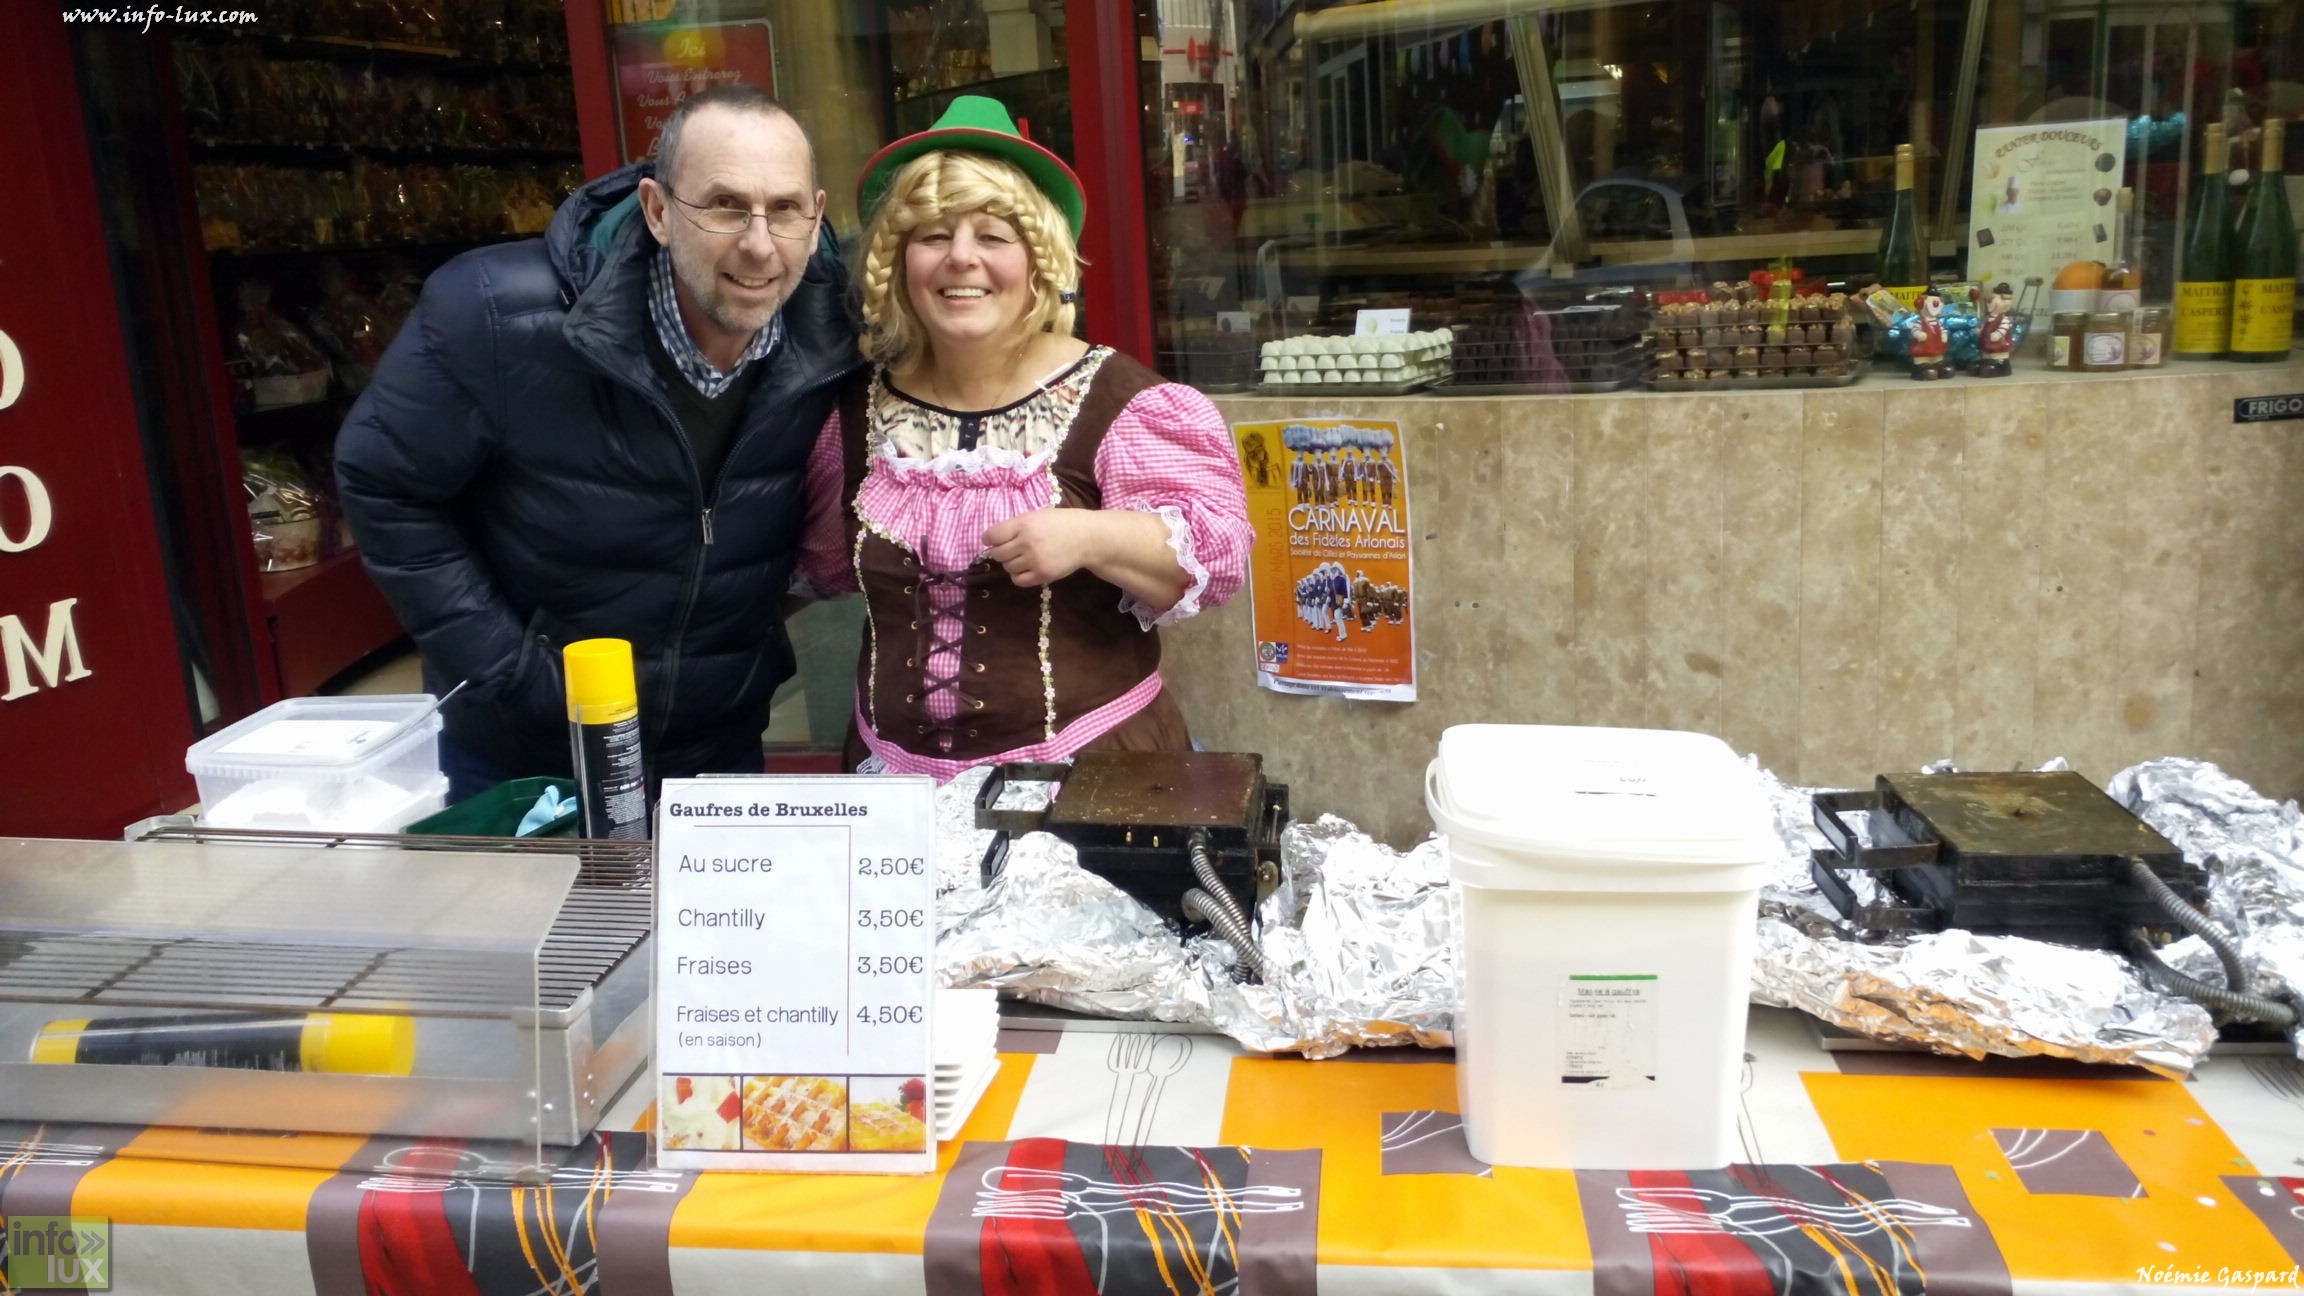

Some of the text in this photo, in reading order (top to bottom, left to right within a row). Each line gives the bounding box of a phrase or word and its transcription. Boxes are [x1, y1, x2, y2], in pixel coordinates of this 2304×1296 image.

[677, 37, 706, 58] Ici
[648, 70, 682, 84] Vous
[637, 93, 671, 107] Vous
[2248, 398, 2303, 415] FRIGO
[1288, 506, 1406, 534] CARNAVAL
[1289, 533, 1310, 546] des
[1354, 534, 1406, 549] Arlonais
[669, 802, 868, 817] Gaufres de Bruxelles
[678, 854, 925, 878] Au sucre 2,50€
[677, 908, 924, 930] Chantilly 3,50€
[676, 956, 924, 977] Fraises 3,50€
[676, 1005, 924, 1026] Fraises et chantilly 4,50€
[678, 1032, 762, 1048] (en saison)
